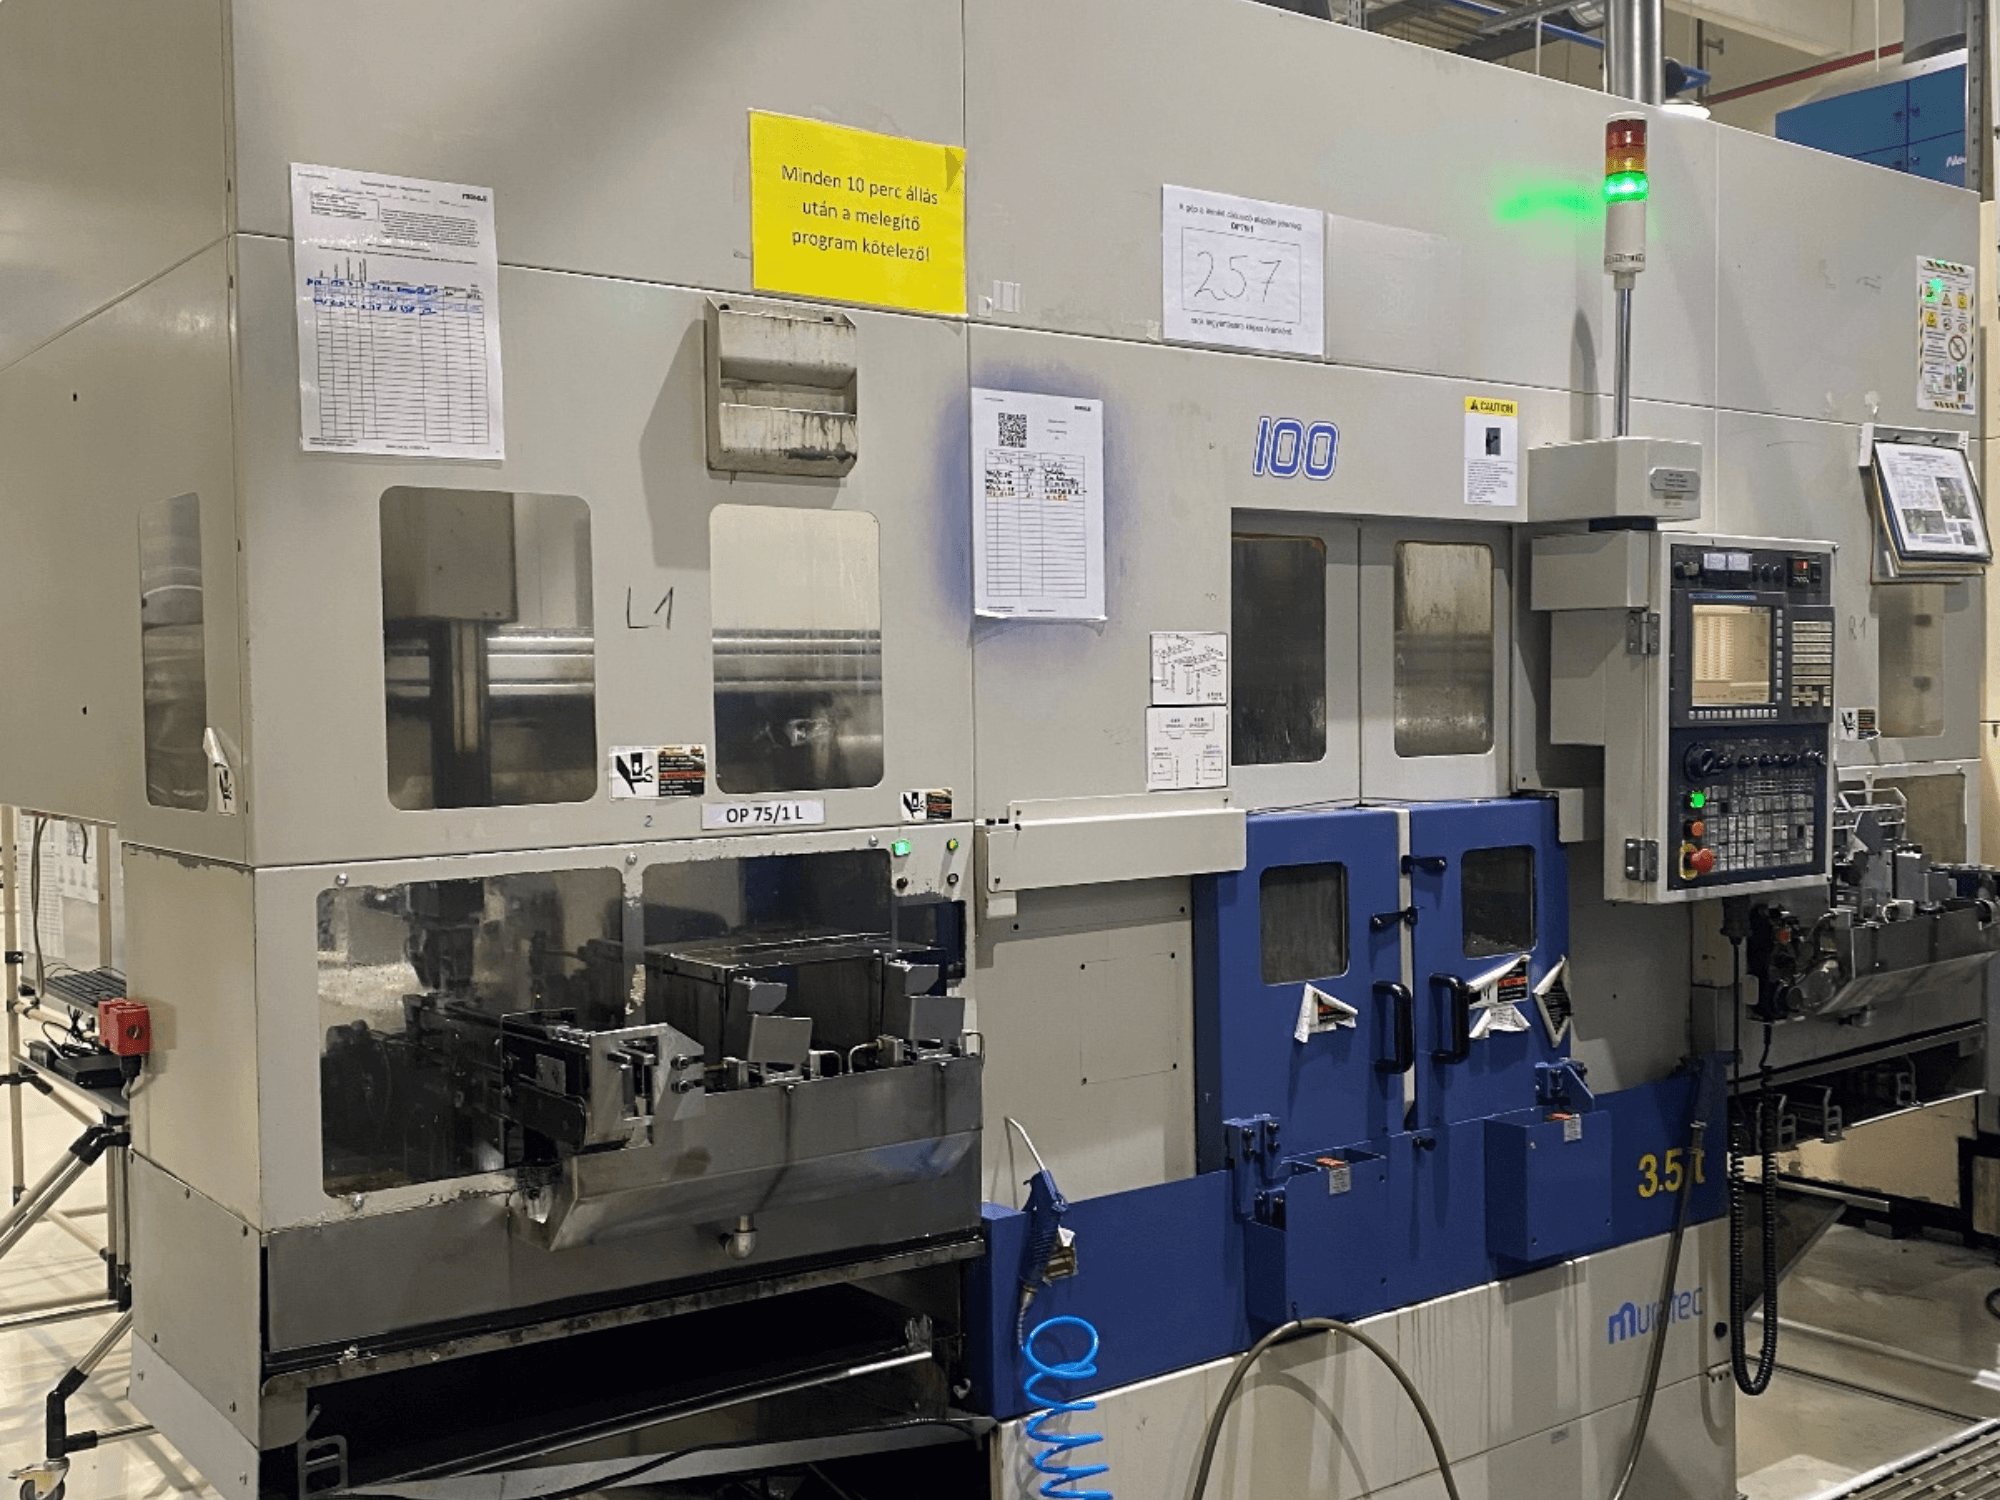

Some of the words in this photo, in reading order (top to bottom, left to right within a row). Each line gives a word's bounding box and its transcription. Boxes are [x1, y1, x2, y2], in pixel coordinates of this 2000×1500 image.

[781, 164, 841, 188] Minden
[848, 176, 865, 193] 10
[869, 183, 902, 198] perc
[906, 185, 938, 205] állás
[802, 200, 838, 218] után
[843, 209, 851, 220] a
[856, 210, 920, 231] melegítő
[792, 230, 858, 251] program
[862, 237, 930, 262] kötelező!
[1194, 250, 1283, 303] 257
[1480, 400, 1514, 414] CAUTION
[1252, 416, 1340, 481] 100
[626, 586, 674, 630] L1
[726, 808, 749, 823] OP
[753, 805, 791, 825] 75/1
[795, 805, 803, 820] L
